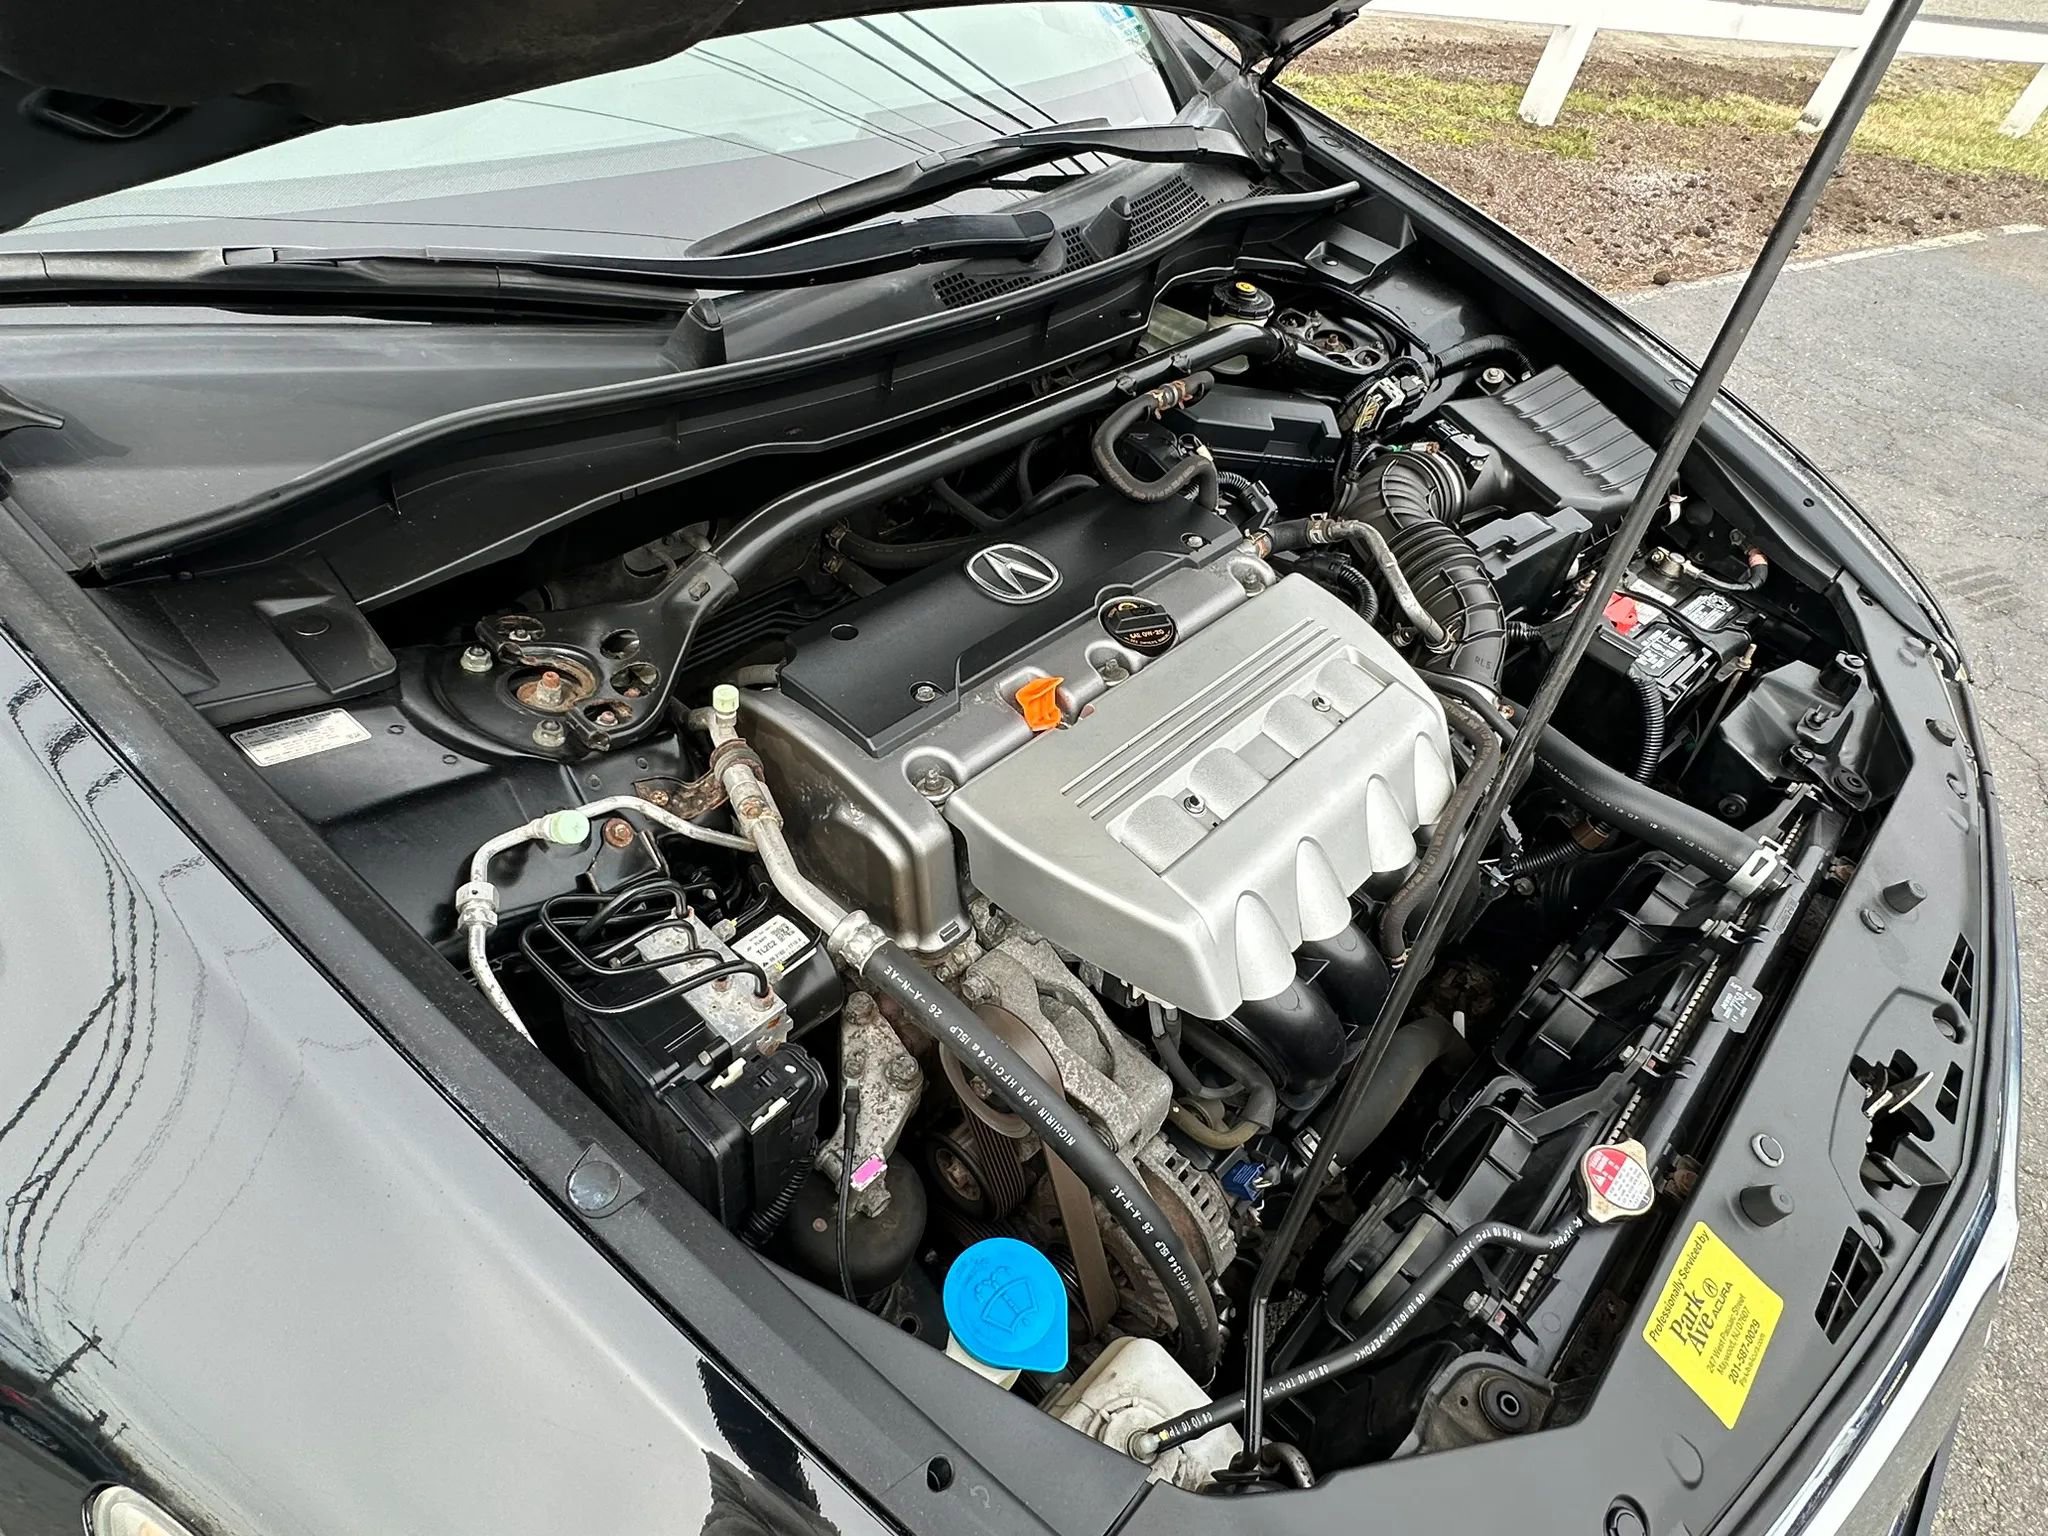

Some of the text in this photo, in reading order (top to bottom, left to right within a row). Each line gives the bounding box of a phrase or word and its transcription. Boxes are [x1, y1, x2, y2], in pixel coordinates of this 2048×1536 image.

[928, 1003, 943, 1018] 26
[970, 1042, 1018, 1089] HFC134a
[1016, 1089, 1038, 1107] JPN
[1037, 1108, 1077, 1146] NICHIRIN
[1141, 1221, 1154, 1234] 26
[1649, 1231, 1710, 1342] Professionally Serviced by
[1669, 1290, 1705, 1345] Park
[1687, 1282, 1733, 1356] Ave ACURA
[1728, 1318, 1761, 1384] 201-587-0029
